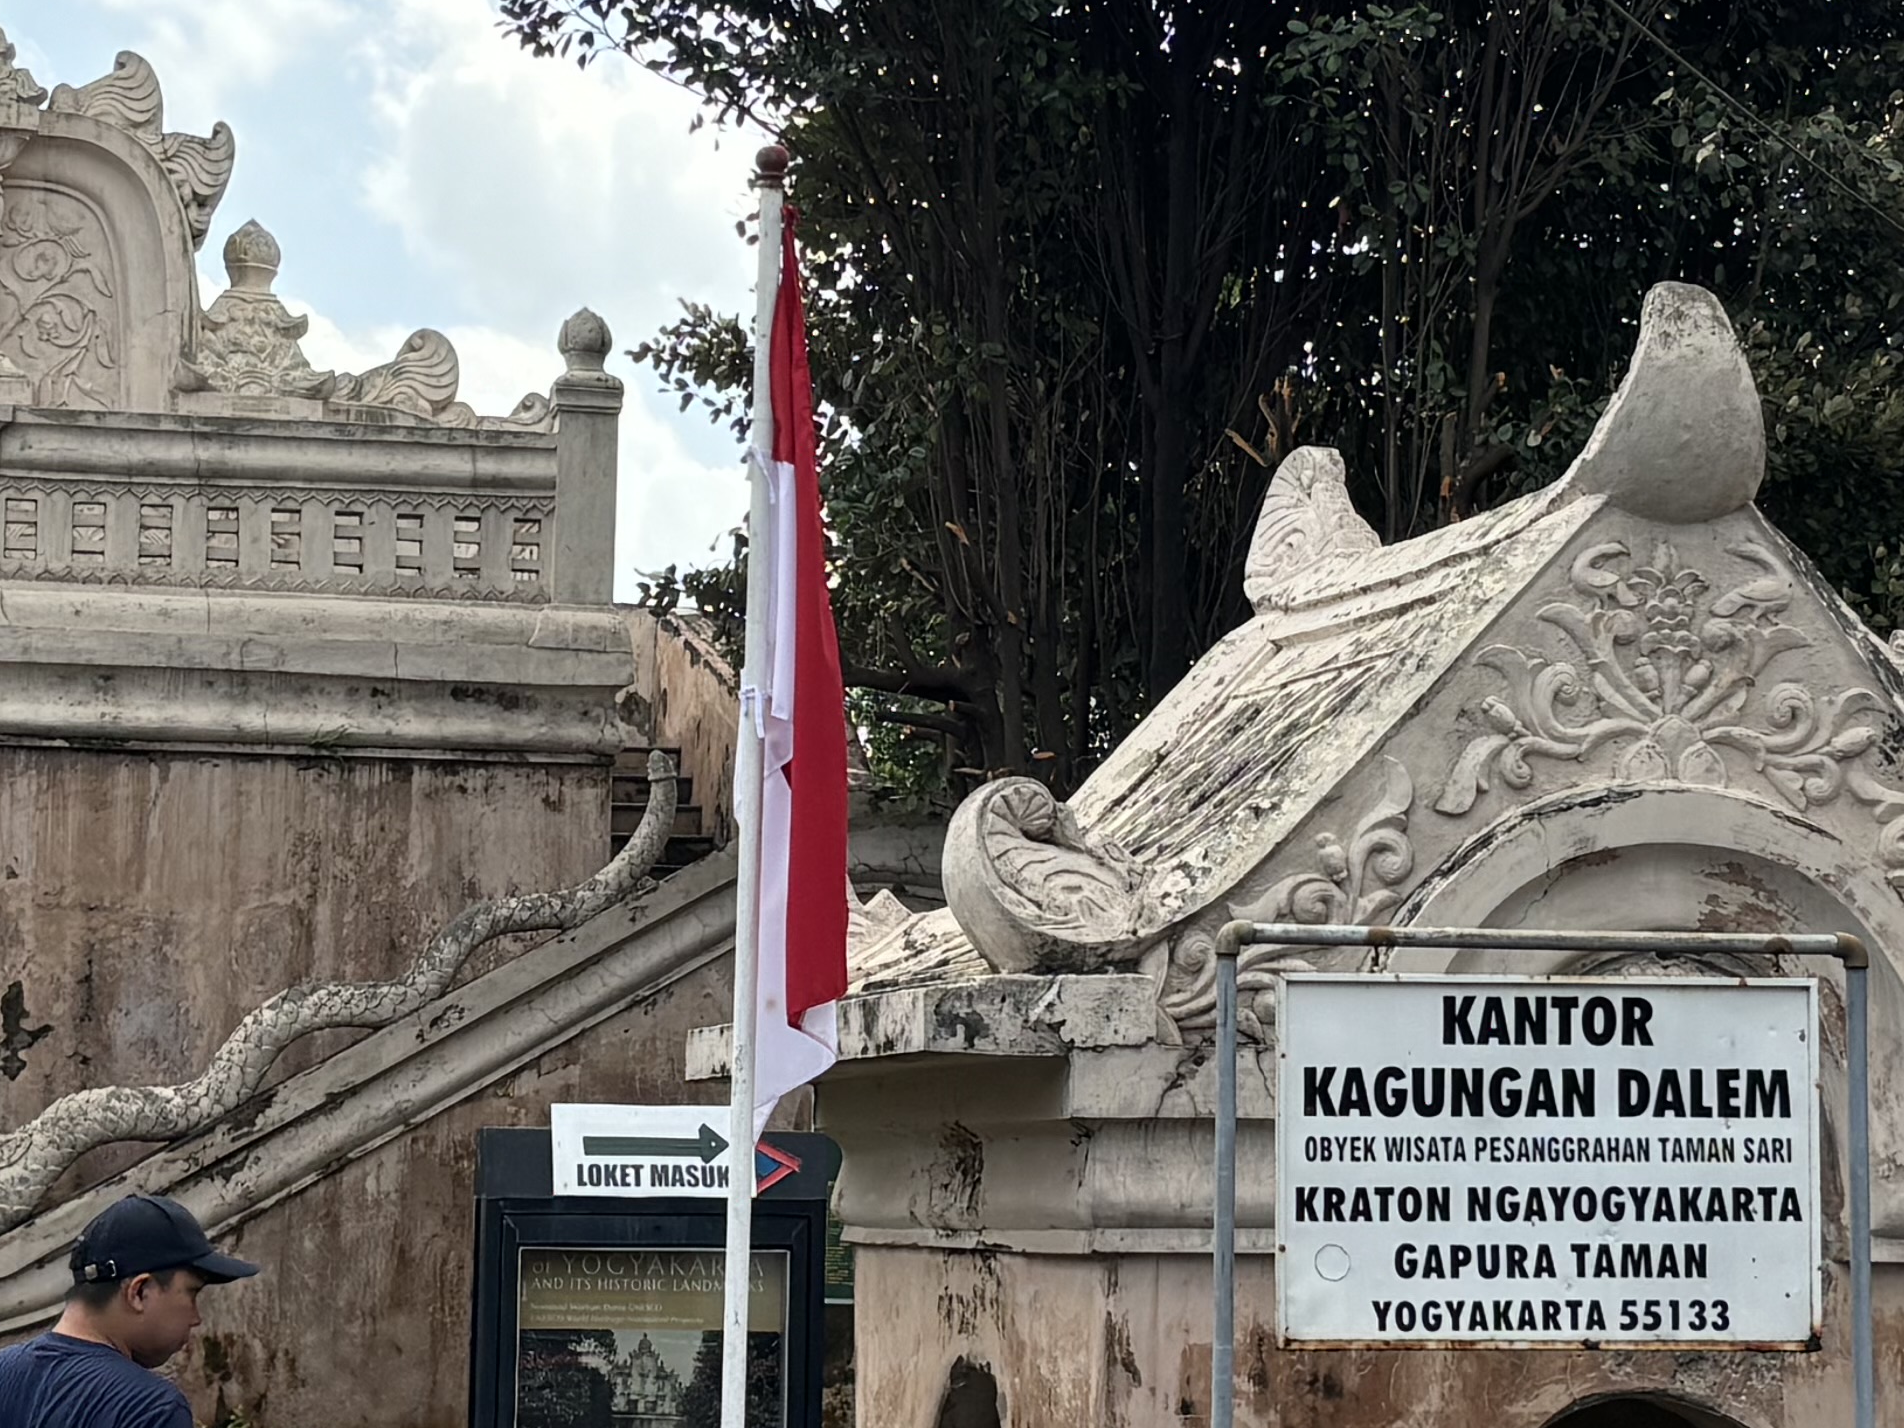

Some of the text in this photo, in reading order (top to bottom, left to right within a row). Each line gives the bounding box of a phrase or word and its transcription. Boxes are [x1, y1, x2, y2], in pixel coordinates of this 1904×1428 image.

[1442, 995, 1655, 1047] KANTOR
[1302, 1066, 1792, 1120] KAGUNGAN DALEM
[1304, 1136, 1793, 1164] OBYEK WISATA PESANGGRAHAN TAMAN SARI
[576, 1163, 729, 1188] LOKET MASUK
[1295, 1185, 1804, 1223] KRATON NGAYOGYAKARTA
[562, 1253, 764, 1277] YOGYAKARA
[1394, 1242, 1708, 1280] GAPURA TAMAN
[530, 1277, 564, 1290] AND
[570, 1277, 592, 1291] ITS
[597, 1278, 667, 1292] HISTORIC
[1372, 1299, 1731, 1333] YOGYAKARTA 55133
